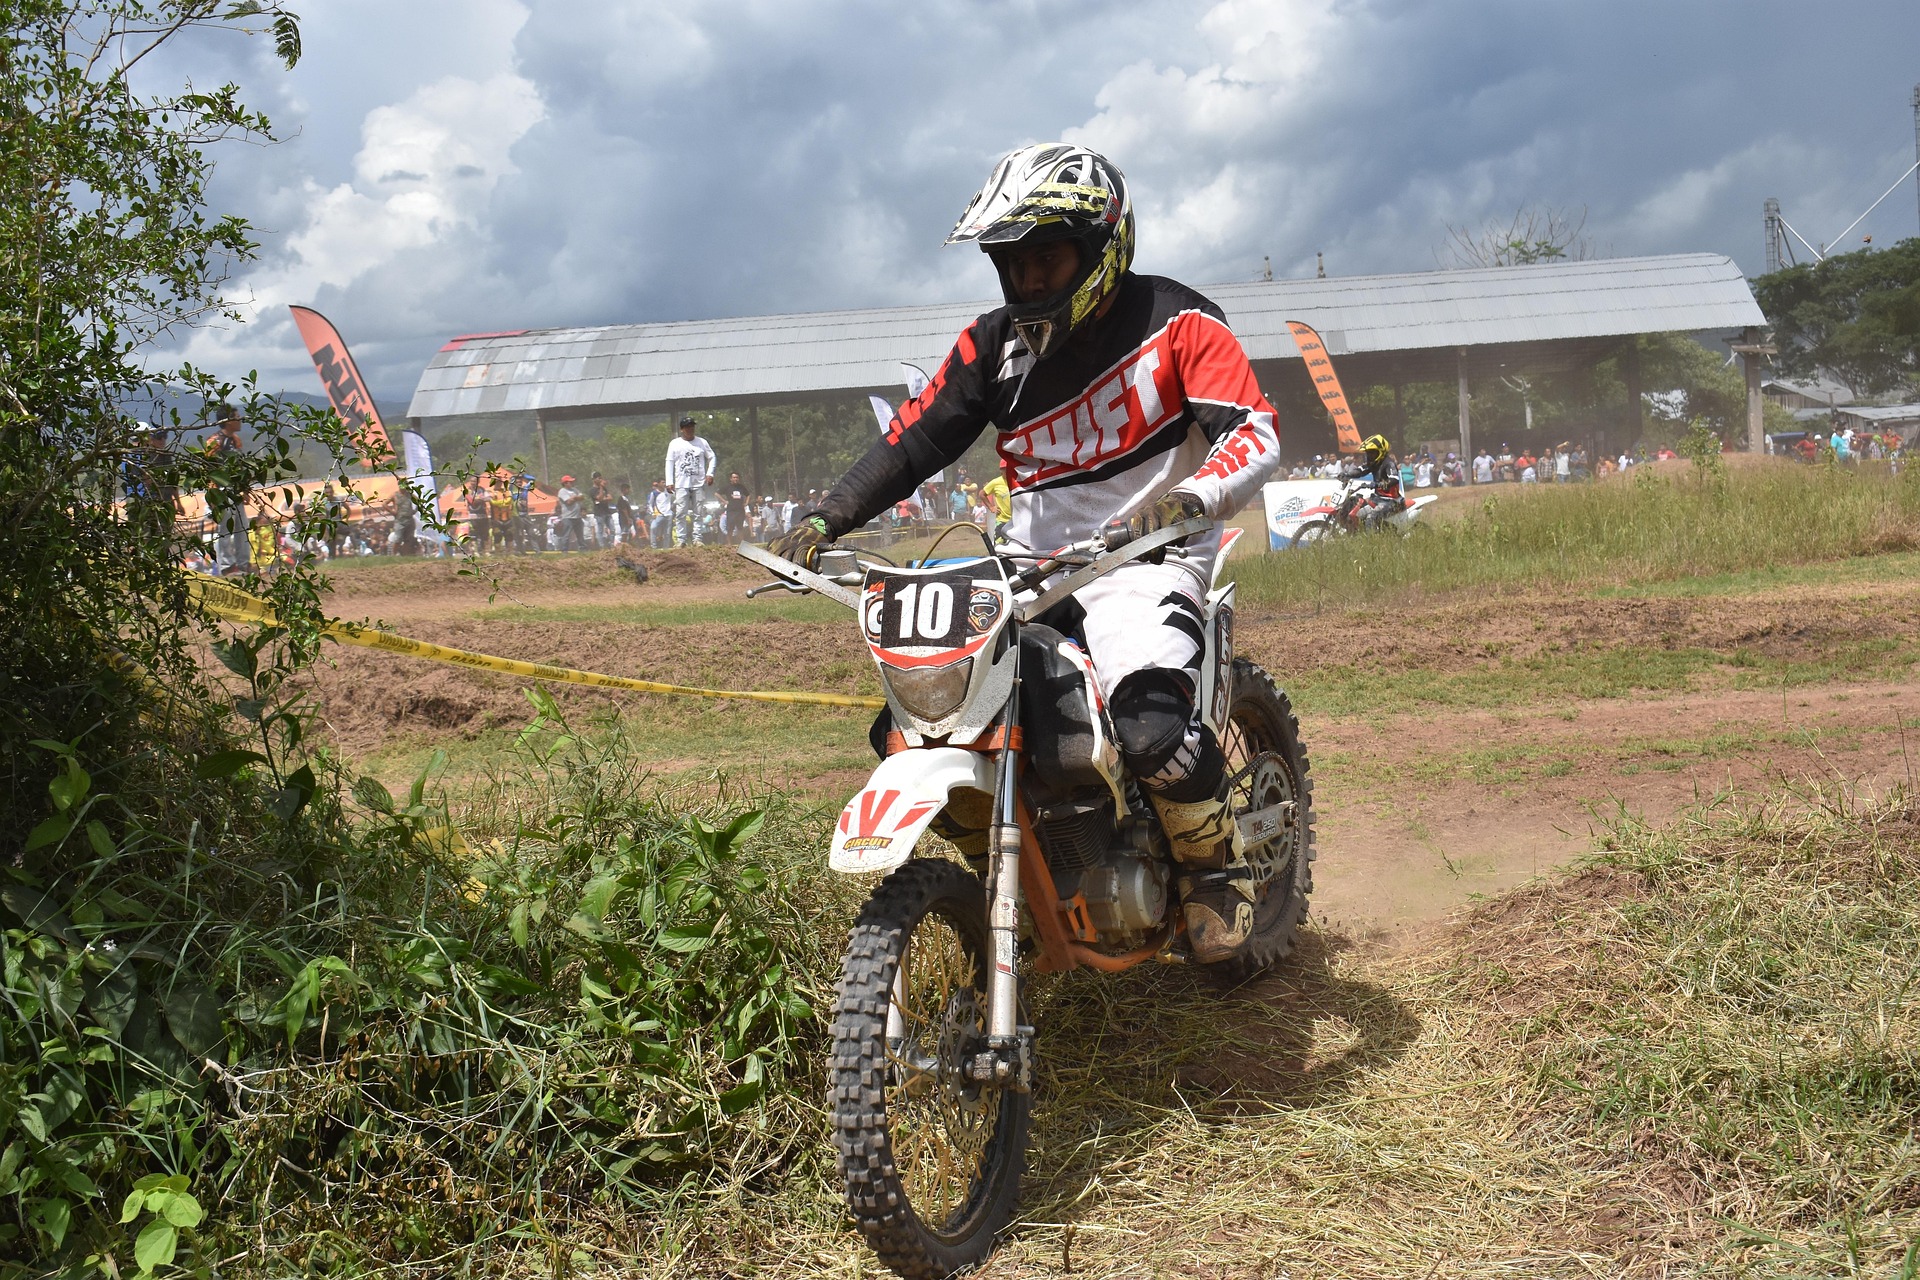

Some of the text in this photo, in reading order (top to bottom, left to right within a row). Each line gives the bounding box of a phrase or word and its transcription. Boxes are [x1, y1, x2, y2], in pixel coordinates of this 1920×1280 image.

[1193, 421, 1266, 481] HIFT
[1275, 511, 1302, 521] OPCIO
[895, 582, 954, 639] 10
[844, 837, 890, 849] CIRCUIT
